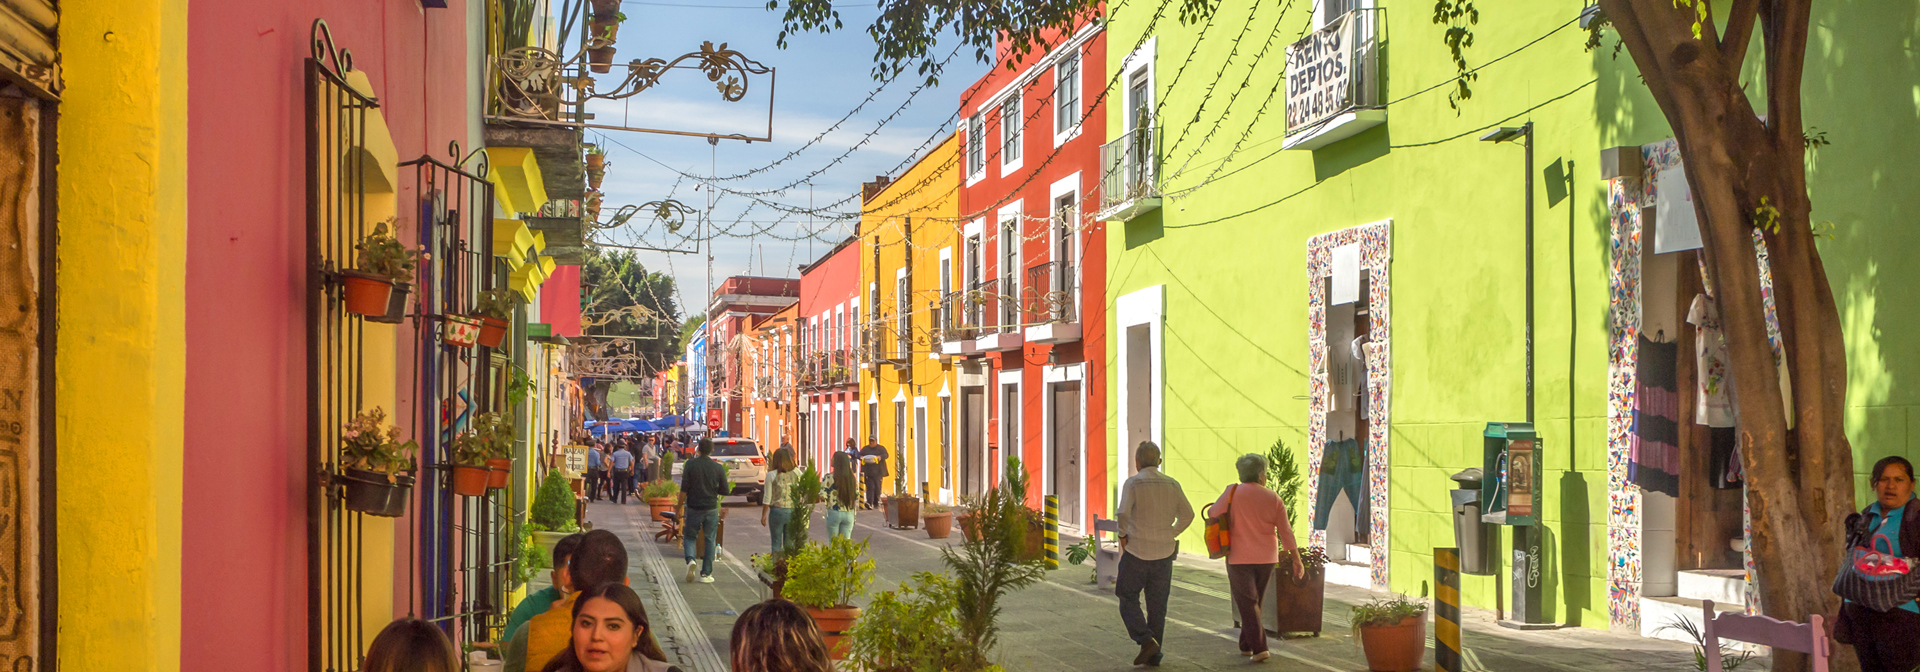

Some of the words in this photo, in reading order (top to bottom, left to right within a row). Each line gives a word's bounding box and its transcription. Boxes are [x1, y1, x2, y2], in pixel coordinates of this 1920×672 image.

[1291, 52, 1347, 98] DEPTOS.
[1299, 96, 1310, 124] 24
[1312, 90, 1323, 118] 48
